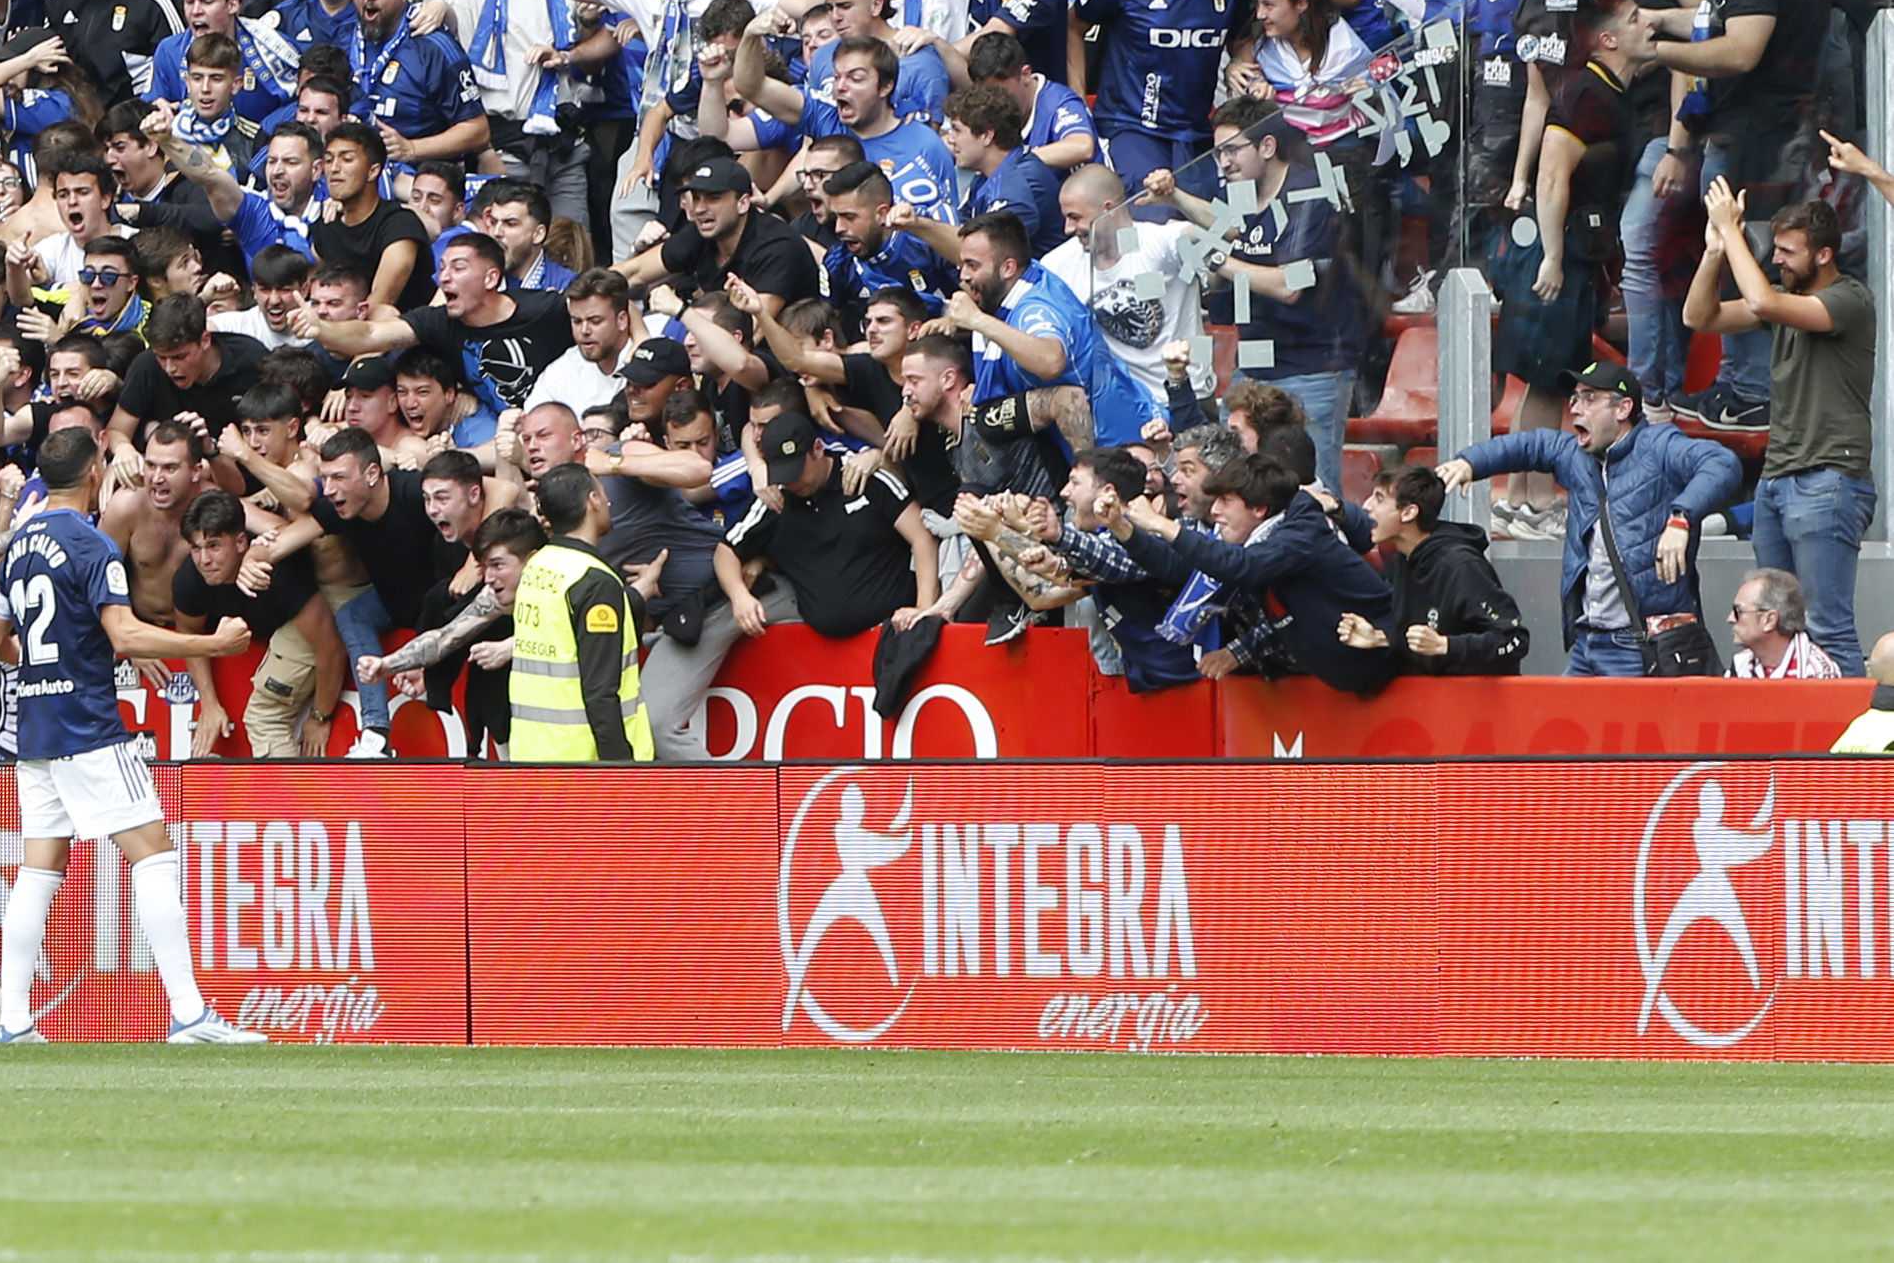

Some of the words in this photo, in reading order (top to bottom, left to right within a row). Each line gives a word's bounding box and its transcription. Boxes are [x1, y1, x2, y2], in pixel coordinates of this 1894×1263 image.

[29, 534, 68, 570] CALVO
[516, 602, 541, 627] 073
[43, 679, 75, 696] Auto
[920, 822, 1198, 979] INTEGRA
[1784, 819, 1894, 979] INT
[236, 976, 387, 1042] energía
[1036, 981, 1208, 1048] energía
